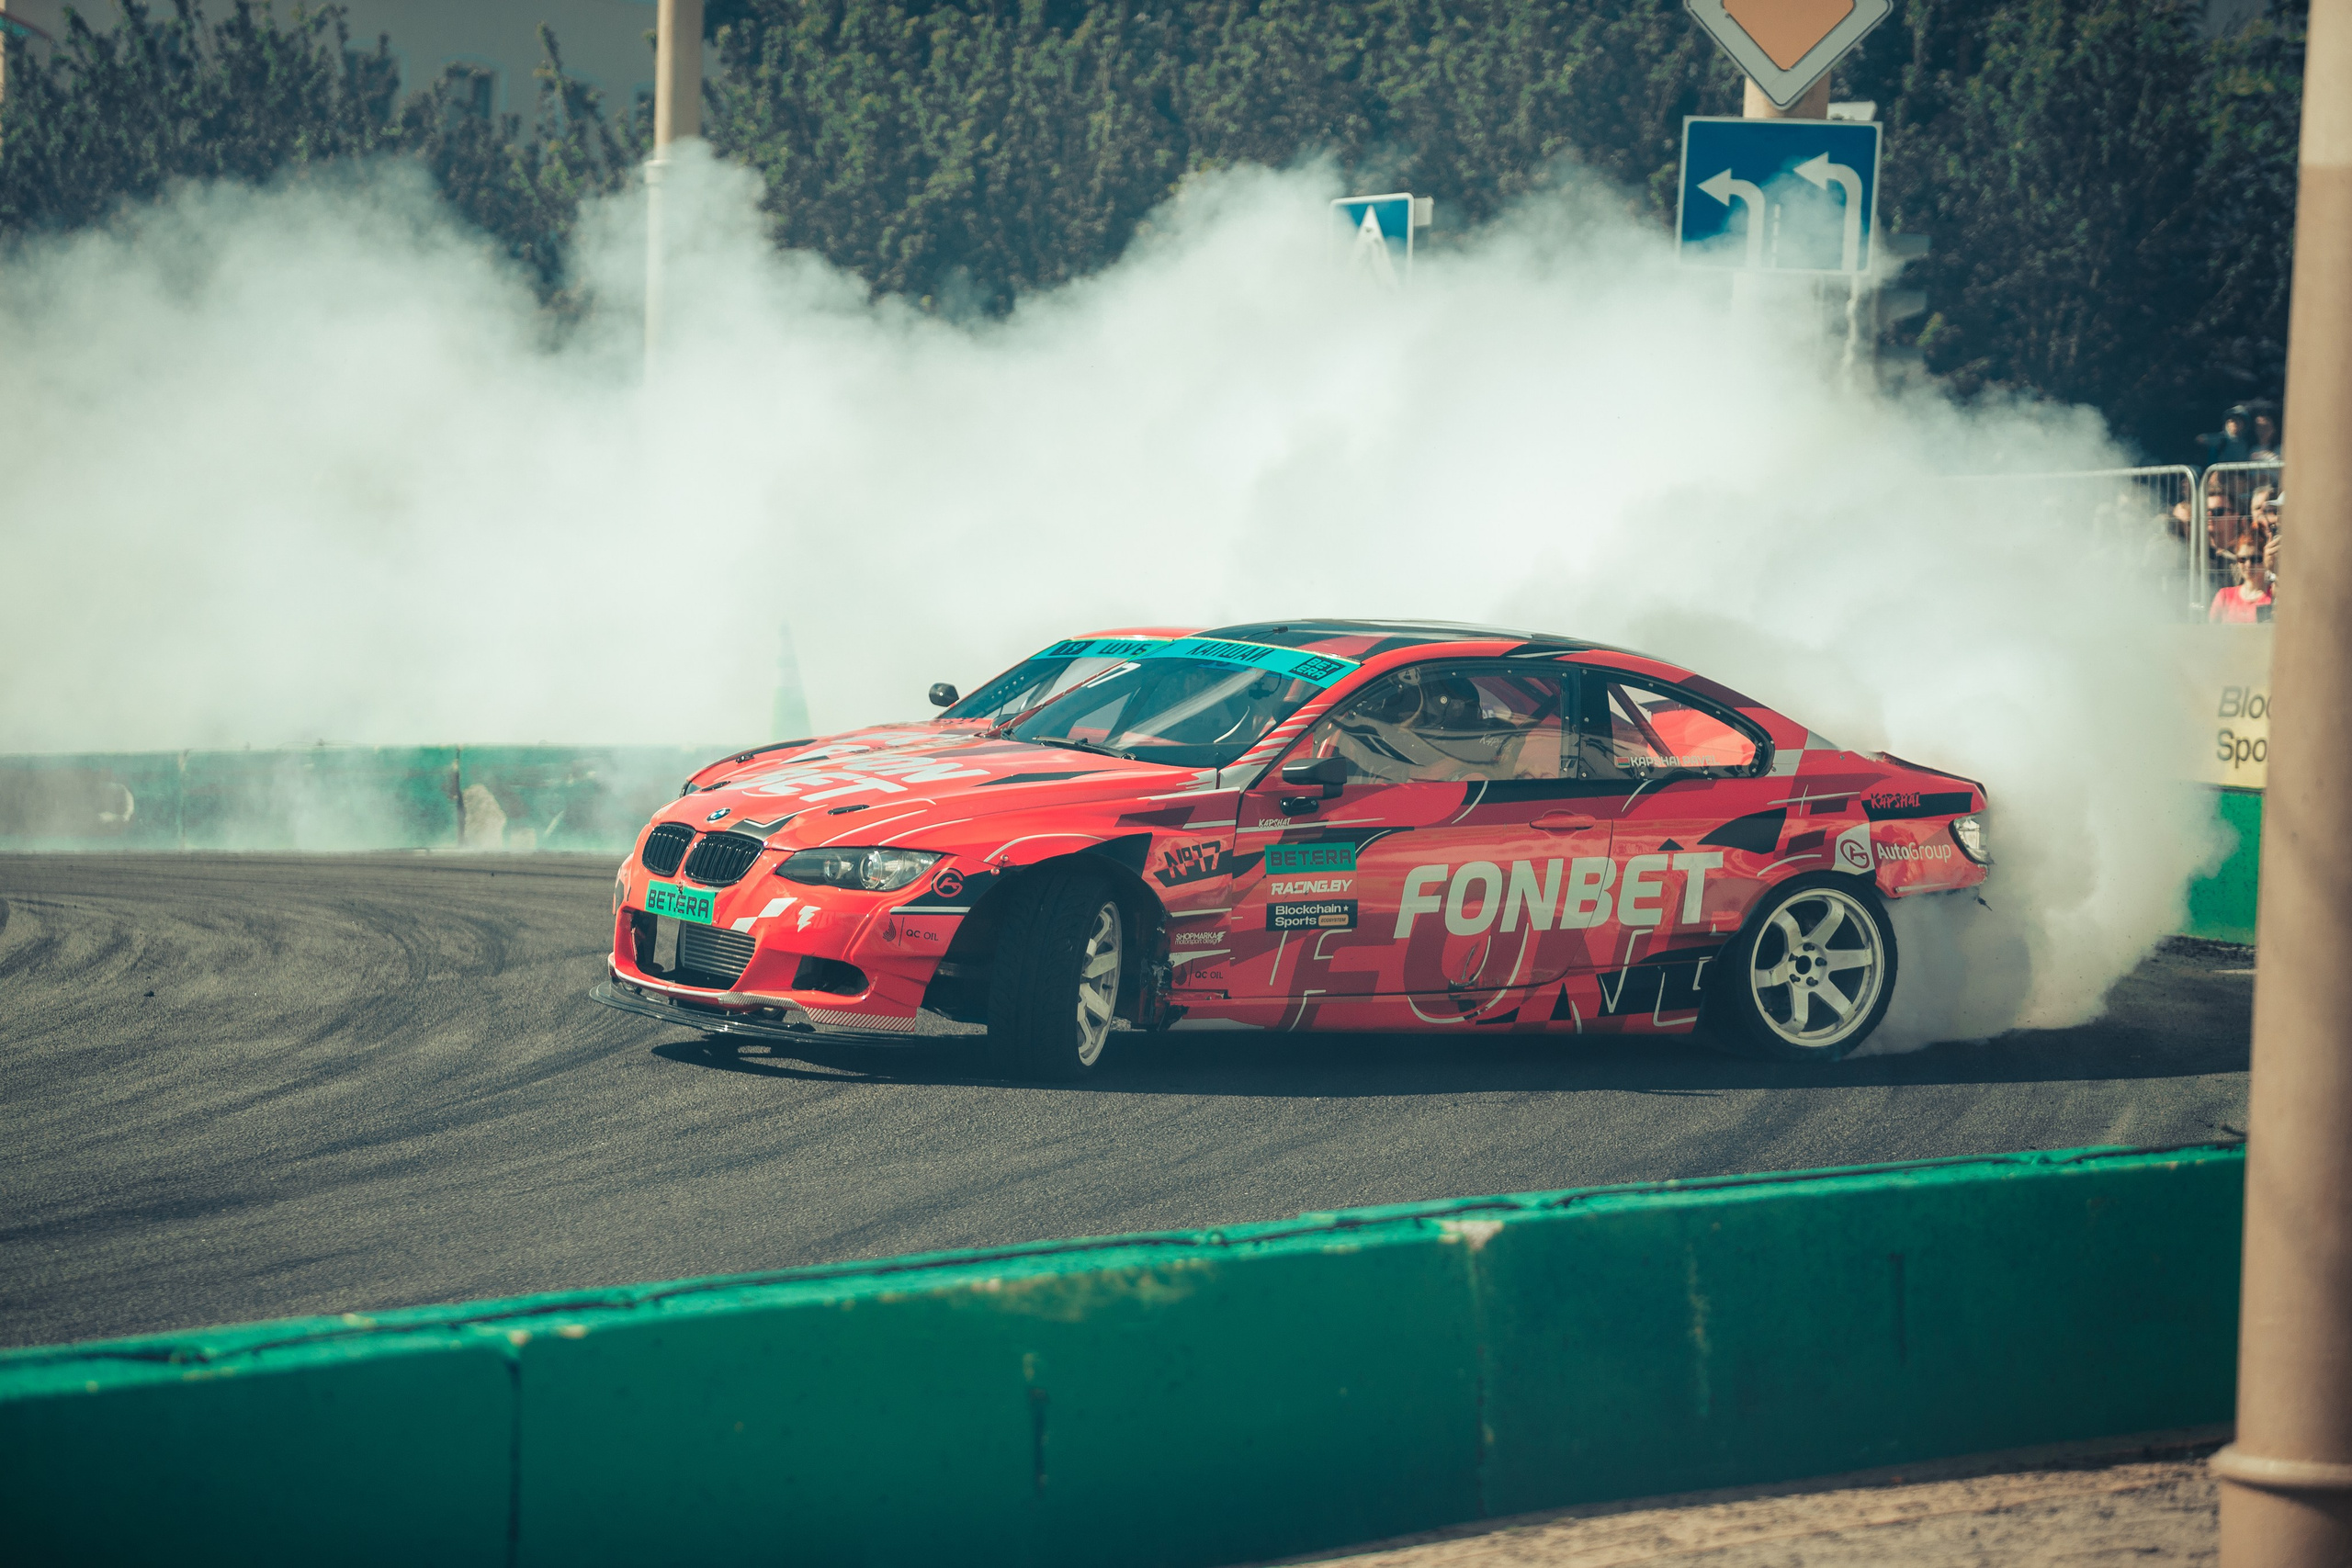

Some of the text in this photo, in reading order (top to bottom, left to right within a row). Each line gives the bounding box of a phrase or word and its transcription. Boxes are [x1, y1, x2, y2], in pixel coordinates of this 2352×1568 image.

[1306, 658, 1340, 671] BET
[1876, 842, 1952, 863] AutoGroup
[1271, 879, 1353, 895] RACING.BY
[1394, 851, 1724, 939] FONBET
[1275, 904, 1341, 915] Blockchain
[1275, 916, 1317, 928] Sports
[906, 929, 939, 942] QC OIL
[1175, 932, 1217, 941] SHOPMARKA
[1194, 971, 1224, 979] QC OIL
